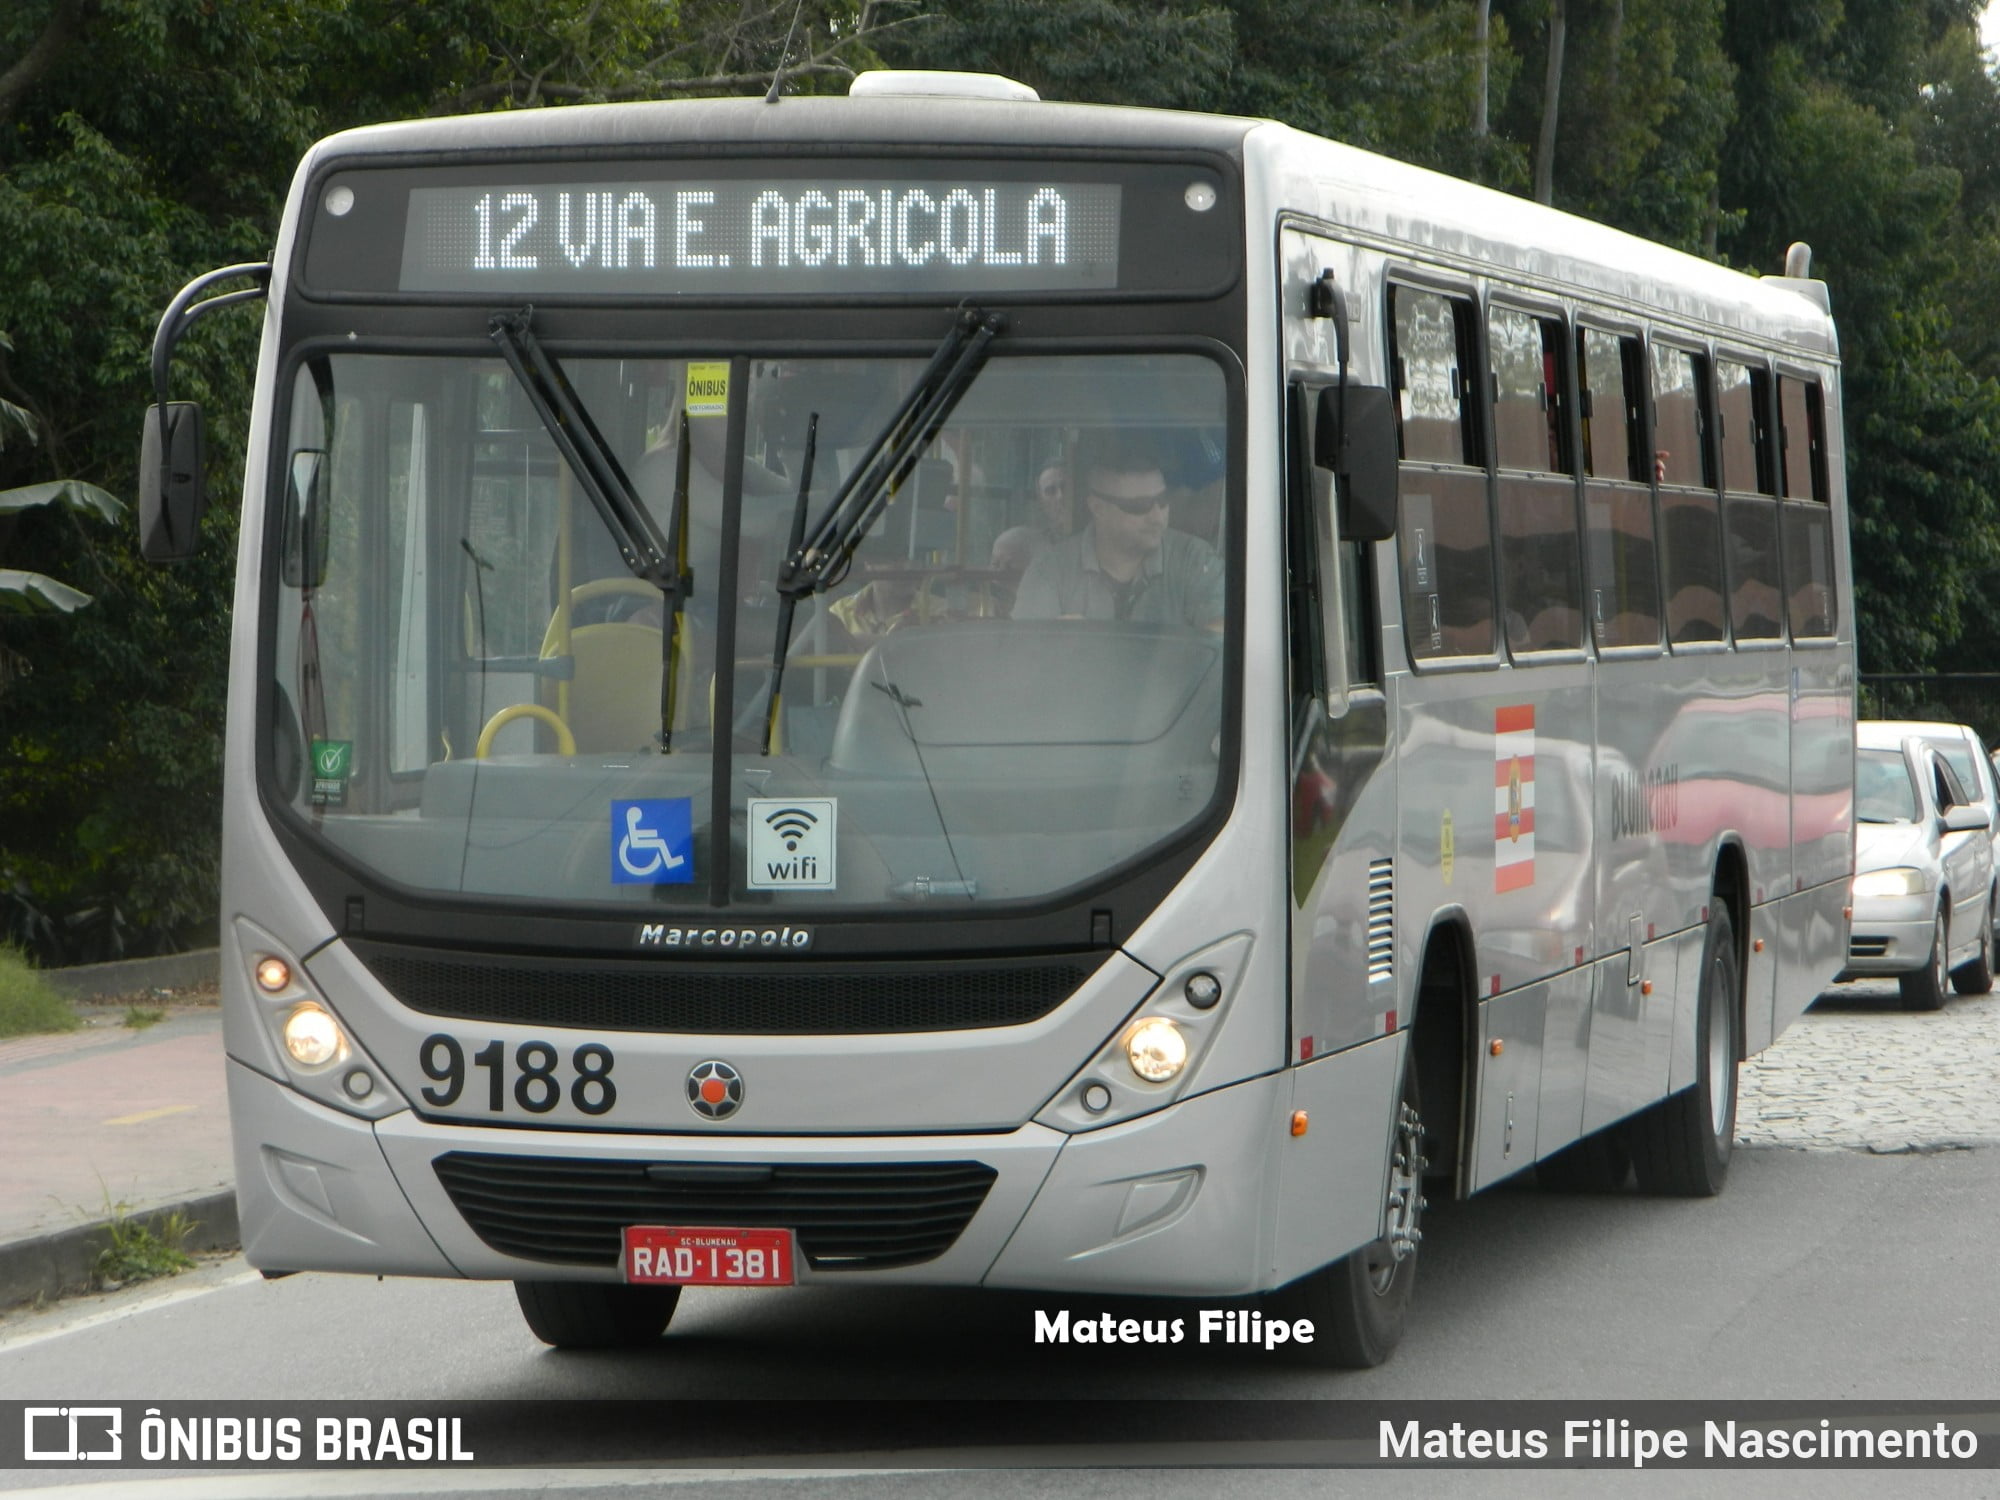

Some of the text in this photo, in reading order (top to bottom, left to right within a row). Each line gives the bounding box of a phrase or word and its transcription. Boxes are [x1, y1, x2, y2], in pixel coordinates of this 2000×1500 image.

[474, 187, 1067, 270] 12 VIA E. AGRICOLA
[768, 857, 817, 880] wifi
[639, 924, 809, 949] Marcopolo
[419, 1033, 617, 1115] 9188
